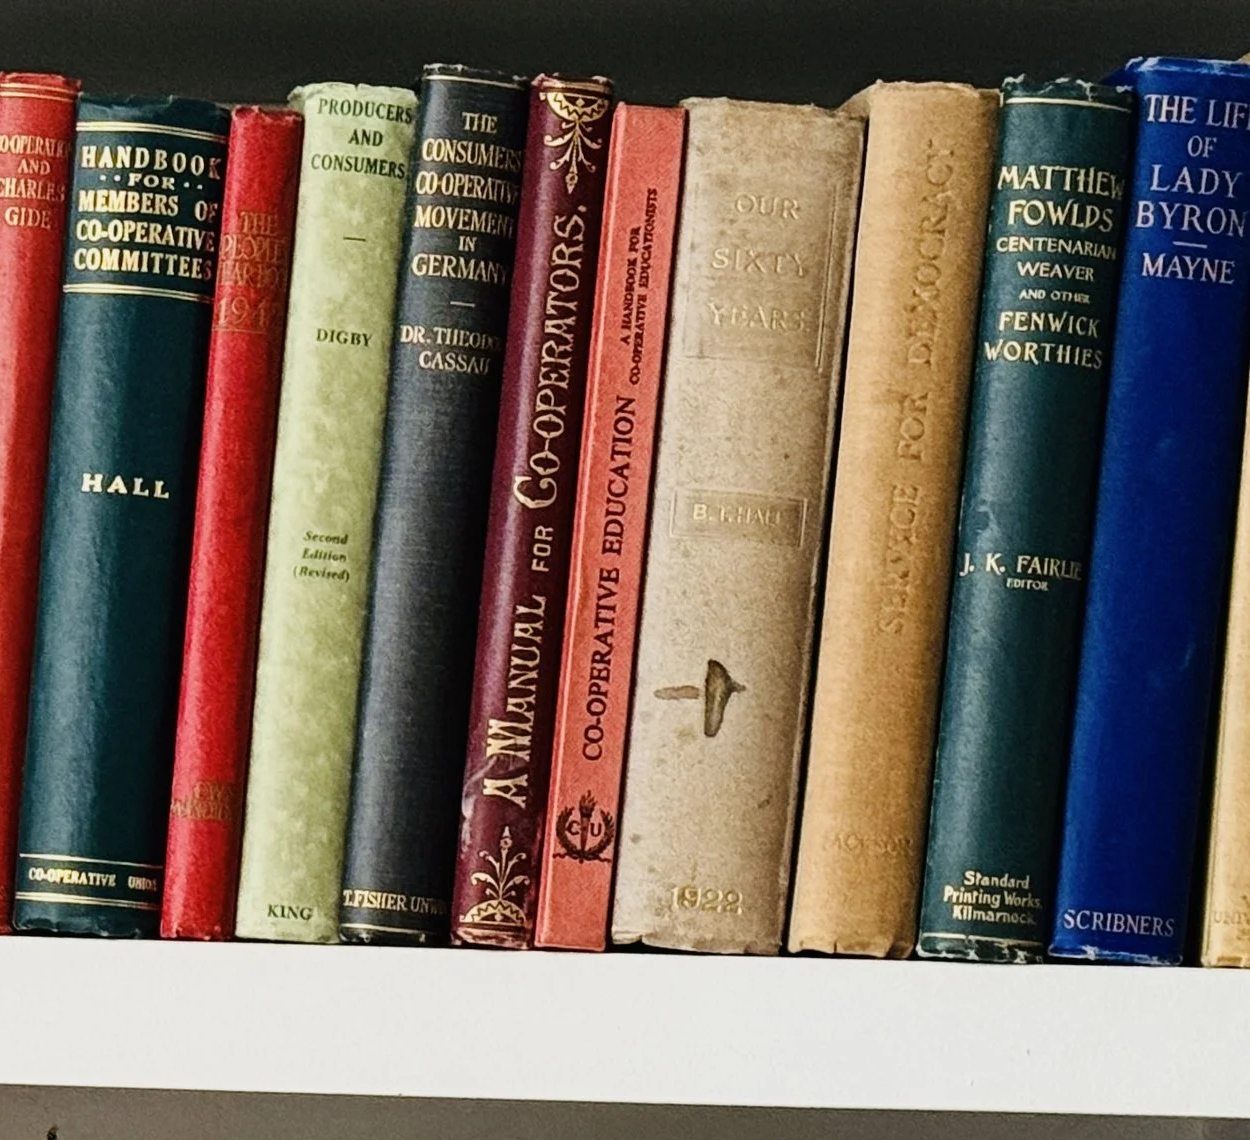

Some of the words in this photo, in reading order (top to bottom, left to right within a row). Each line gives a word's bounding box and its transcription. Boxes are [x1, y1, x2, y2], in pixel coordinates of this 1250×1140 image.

[318, 97, 413, 125] PRODUCERS
[462, 111, 497, 133] THE
[1144, 94, 1197, 124] THE
[348, 128, 383, 148] AND
[1187, 134, 1217, 158] OF
[18, 159, 50, 175] AND
[81, 146, 221, 180] HANDBOOK
[311, 153, 405, 180] CONSUMERS
[128, 173, 175, 190] FOR
[997, 165, 1126, 200] MATTHEW
[1150, 164, 1243, 198] LADY
[78, 190, 179, 217] MEMBERS
[1007, 199, 1113, 233] FOWLDS
[5, 207, 50, 229] GIDE
[1135, 200, 1248, 238] BYRON
[76, 219, 214, 252] CO-OPERATIVE
[458, 235, 477, 252] IN
[996, 237, 1117, 261] CENTENARIAN
[74, 248, 212, 281] COMMITTEES
[1017, 261, 1094, 282] WEAVER
[1141, 252, 1236, 285] MAYNE
[621, 255, 638, 332] HANDBOOK
[1019, 289, 1046, 301] AND
[316, 327, 372, 347] DIGBY
[999, 311, 1100, 338] FENWICK
[628, 294, 648, 386] CO-OPERATIVE
[984, 340, 1102, 370] WORTHIES
[81, 473, 169, 499] HALL
[302, 530, 348, 545] Second
[301, 549, 346, 563] Edition
[985, 553, 1006, 575] K.
[293, 566, 350, 583] (Revised)
[582, 567, 621, 762] CO-OPERATIVE
[602, 395, 637, 556] EDUCATION
[486, 595, 548, 761] MANUAL
[532, 525, 554, 573] FOR
[29, 867, 116, 887] CO-OPERATIVE
[963, 870, 1030, 889] Standard
[943, 885, 1000, 908] Printing
[266, 903, 313, 921] KING
[1063, 909, 1175, 937] SCRIBNERS
